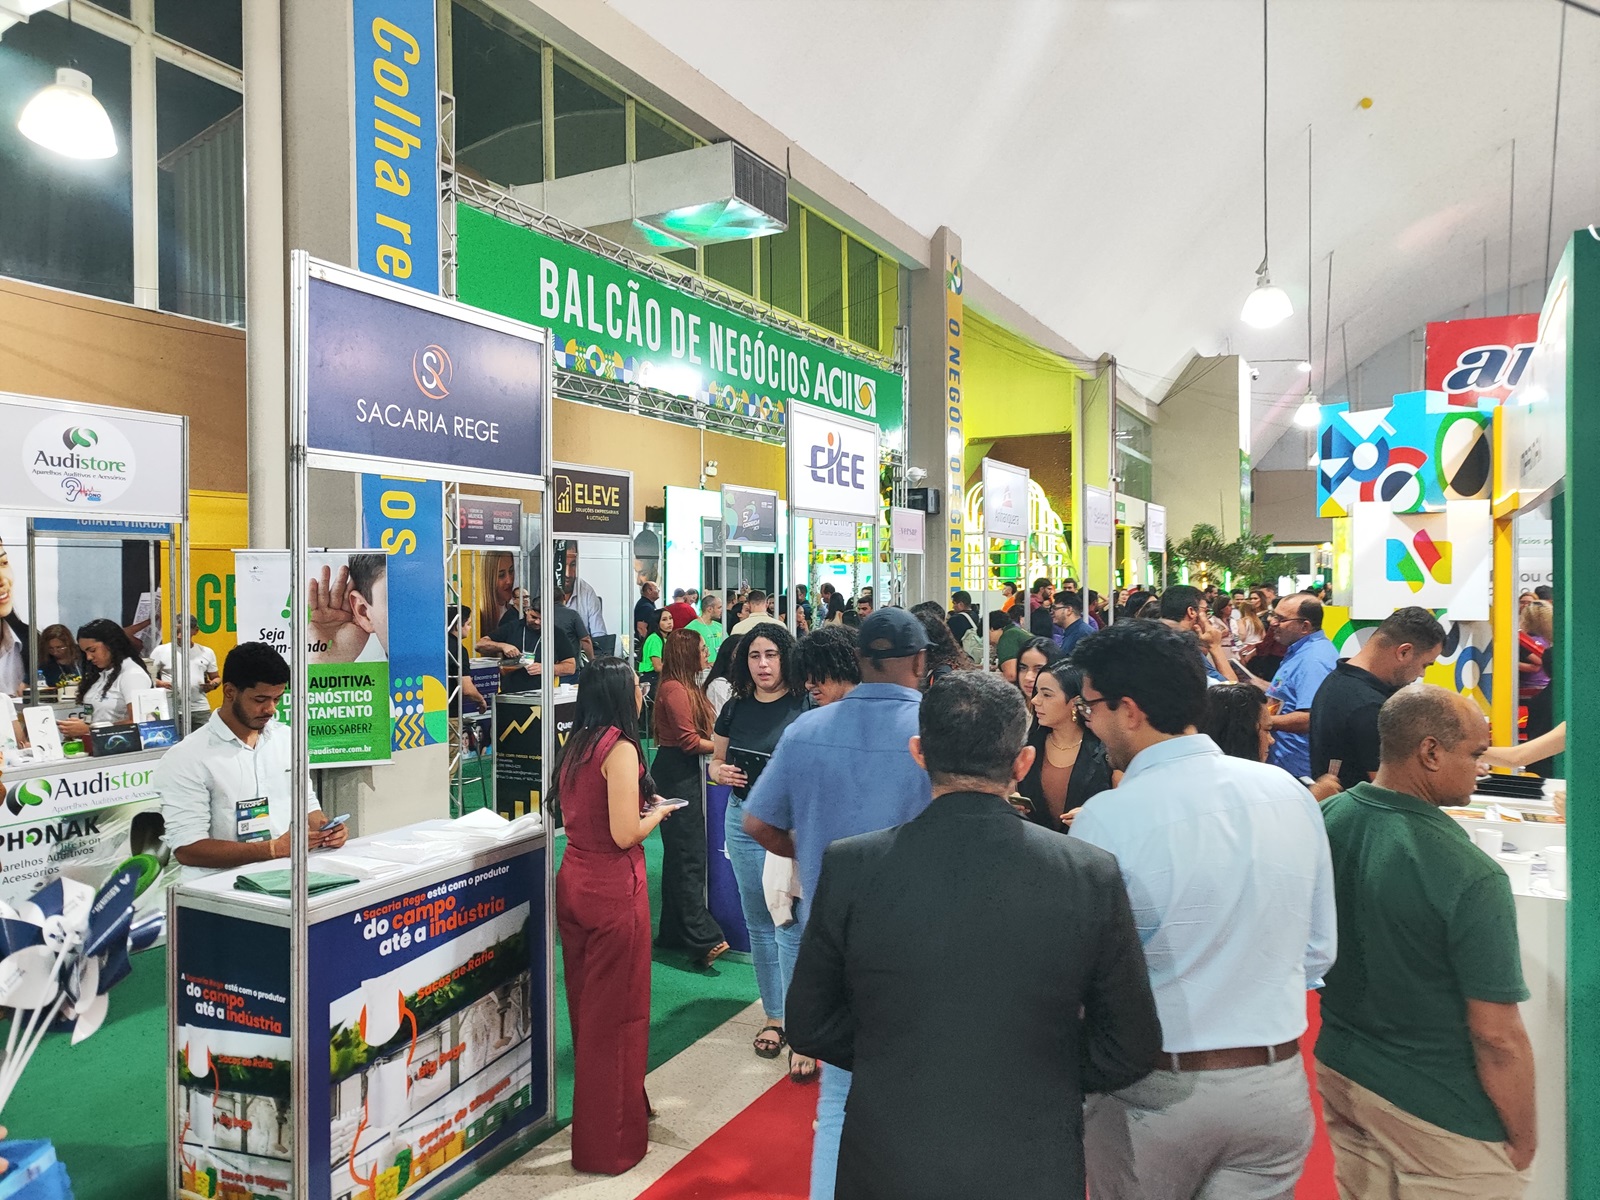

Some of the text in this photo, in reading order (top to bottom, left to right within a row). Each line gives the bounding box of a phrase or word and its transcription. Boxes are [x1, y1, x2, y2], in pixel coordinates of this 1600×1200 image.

[372, 16, 421, 198] Colha
[539, 257, 662, 353] BALCÃO
[671, 308, 701, 365] DE
[709, 321, 811, 399] NEGÓCIOS
[949, 317, 962, 339] O
[355, 398, 500, 444] SACARIA REGE
[949, 345, 963, 472] NEGÓCO
[32, 468, 62, 477] Aparelhos
[63, 470, 92, 479] Auditivos
[33, 449, 126, 473] Audistore
[805, 432, 865, 491] CIEE
[574, 482, 620, 508] ELEVE
[196, 573, 238, 635] GE
[259, 627, 285, 644] Seja
[310, 675, 376, 690] AUDITIVA:
[338, 722, 373, 736] SABER?
[55, 768, 154, 801] Audistor
[46, 846, 95, 863] Auditivos
[353, 913, 362, 925] A
[363, 900, 402, 920] Sacaria
[427, 884, 448, 900] está
[448, 879, 467, 893] com
[468, 876, 474, 885] o
[474, 865, 510, 886] produtor
[363, 895, 456, 941] do campo
[379, 896, 506, 957] até a indústria
[181, 972, 186, 981] A
[225, 983, 238, 991] está
[239, 987, 253, 996] com
[258, 991, 287, 1004] produtor
[416, 949, 495, 1001] Sacos de Ráfia
[186, 982, 245, 1008] do campo
[195, 1001, 283, 1034] até a indústria
